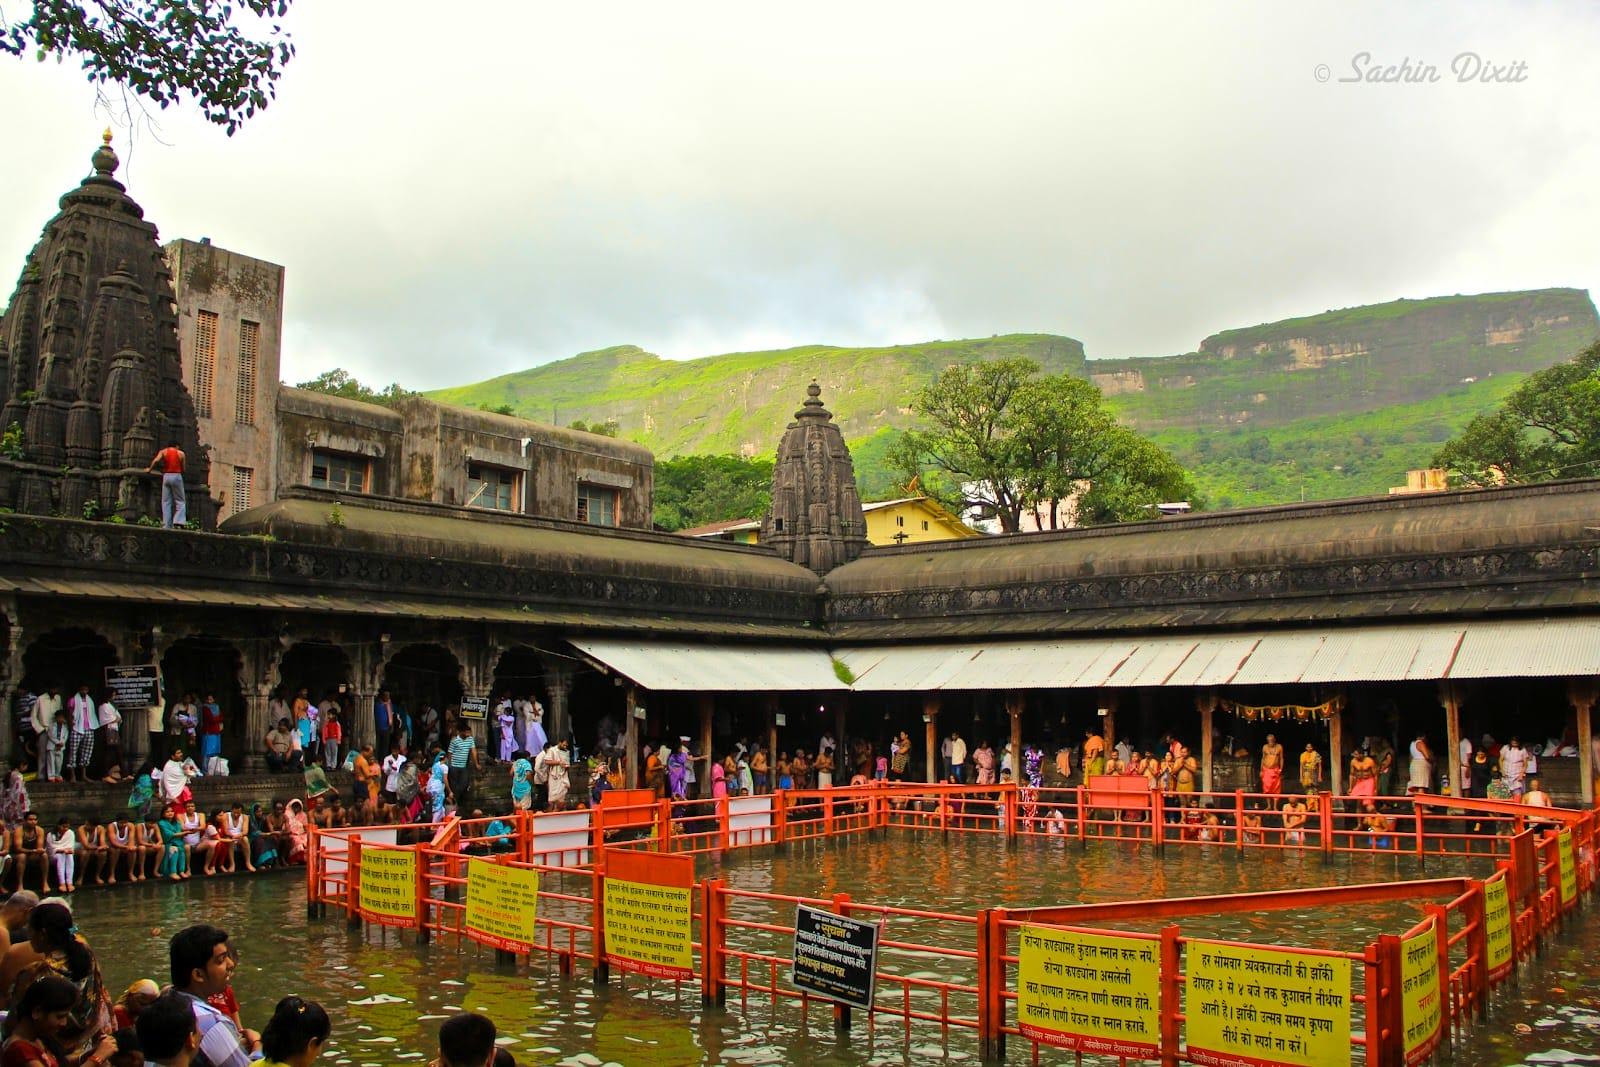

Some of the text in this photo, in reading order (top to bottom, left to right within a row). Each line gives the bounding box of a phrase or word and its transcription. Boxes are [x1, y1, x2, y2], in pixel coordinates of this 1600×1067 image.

[1100, 946, 1117, 960] स्नान
[1202, 954, 1210, 968] हर
[1214, 950, 1241, 968] सोमवार
[1295, 960, 1307, 979] की
[1100, 967, 1131, 985] असलेली
[1091, 989, 1108, 1006] पाणी
[1192, 971, 1214, 993] दोपहर
[1218, 979, 1223, 991] ३
[1227, 976, 1234, 995] से
[1238, 983, 1243, 996] ४
[1247, 980, 1261, 998] बजे
[1264, 987, 1278, 1000] तक
[1281, 985, 1312, 1007] कुशावर्त
[1053, 1006, 1068, 1023] पाणी
[1103, 1017, 1122, 1030] स्नान
[1201, 1000, 1219, 1017] आती
[1260, 1011, 1282, 1027] उत्सव
[1285, 1014, 1305, 1030] समय
[1309, 1017, 1333, 1037] कृपया
[1222, 1026, 1238, 1044] तीर्थ
[1241, 1028, 1251, 1047] को
[1255, 1032, 1272, 1049] स्पर्श
[1275, 1037, 1285, 1051] ना
